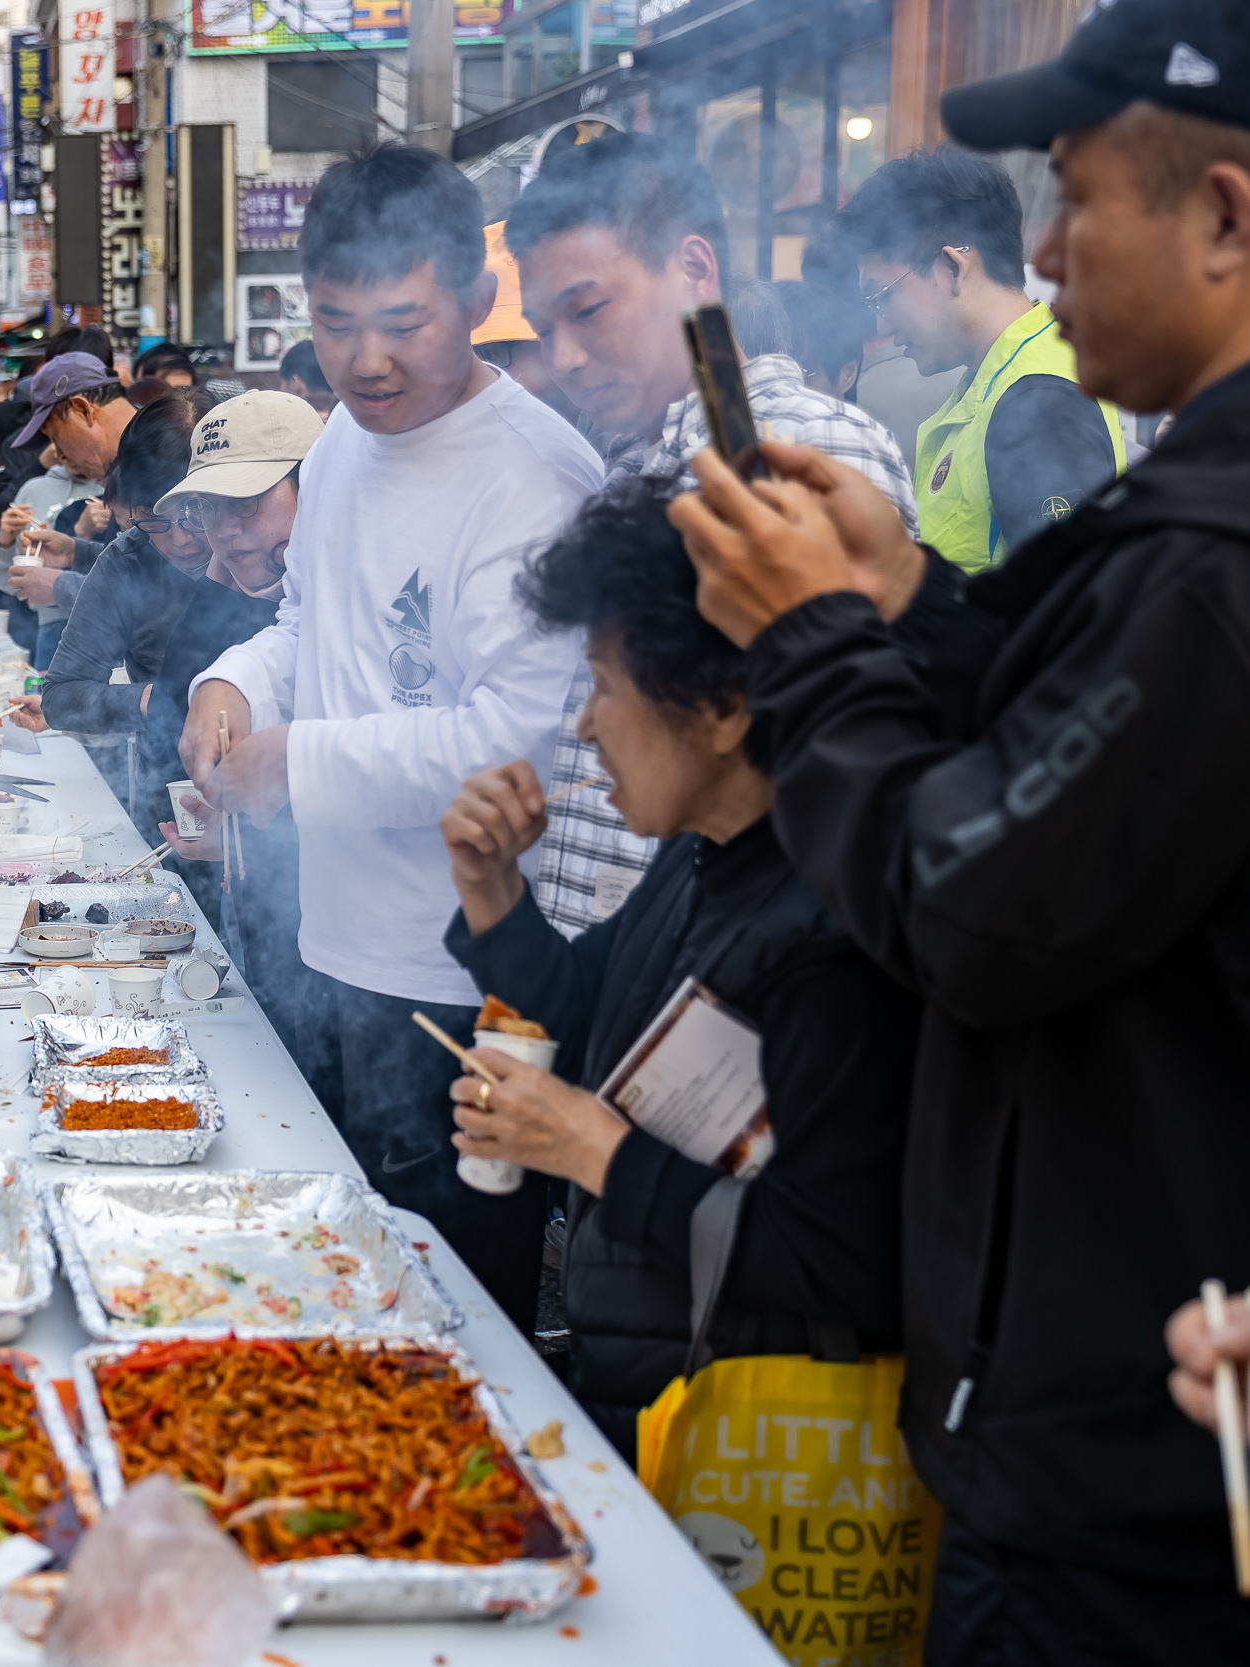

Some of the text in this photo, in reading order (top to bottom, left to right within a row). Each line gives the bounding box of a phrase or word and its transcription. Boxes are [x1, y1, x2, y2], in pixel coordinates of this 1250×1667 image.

[72, 10, 104, 127] 양꼬치
[201, 419, 227, 432] CHAT
[204, 432, 219, 441] de
[197, 440, 230, 455] LAMA
[393, 686, 432, 702] THE APEX
[770, 1514, 923, 1557] I LOVE
[770, 1563, 921, 1603] CLEAN
